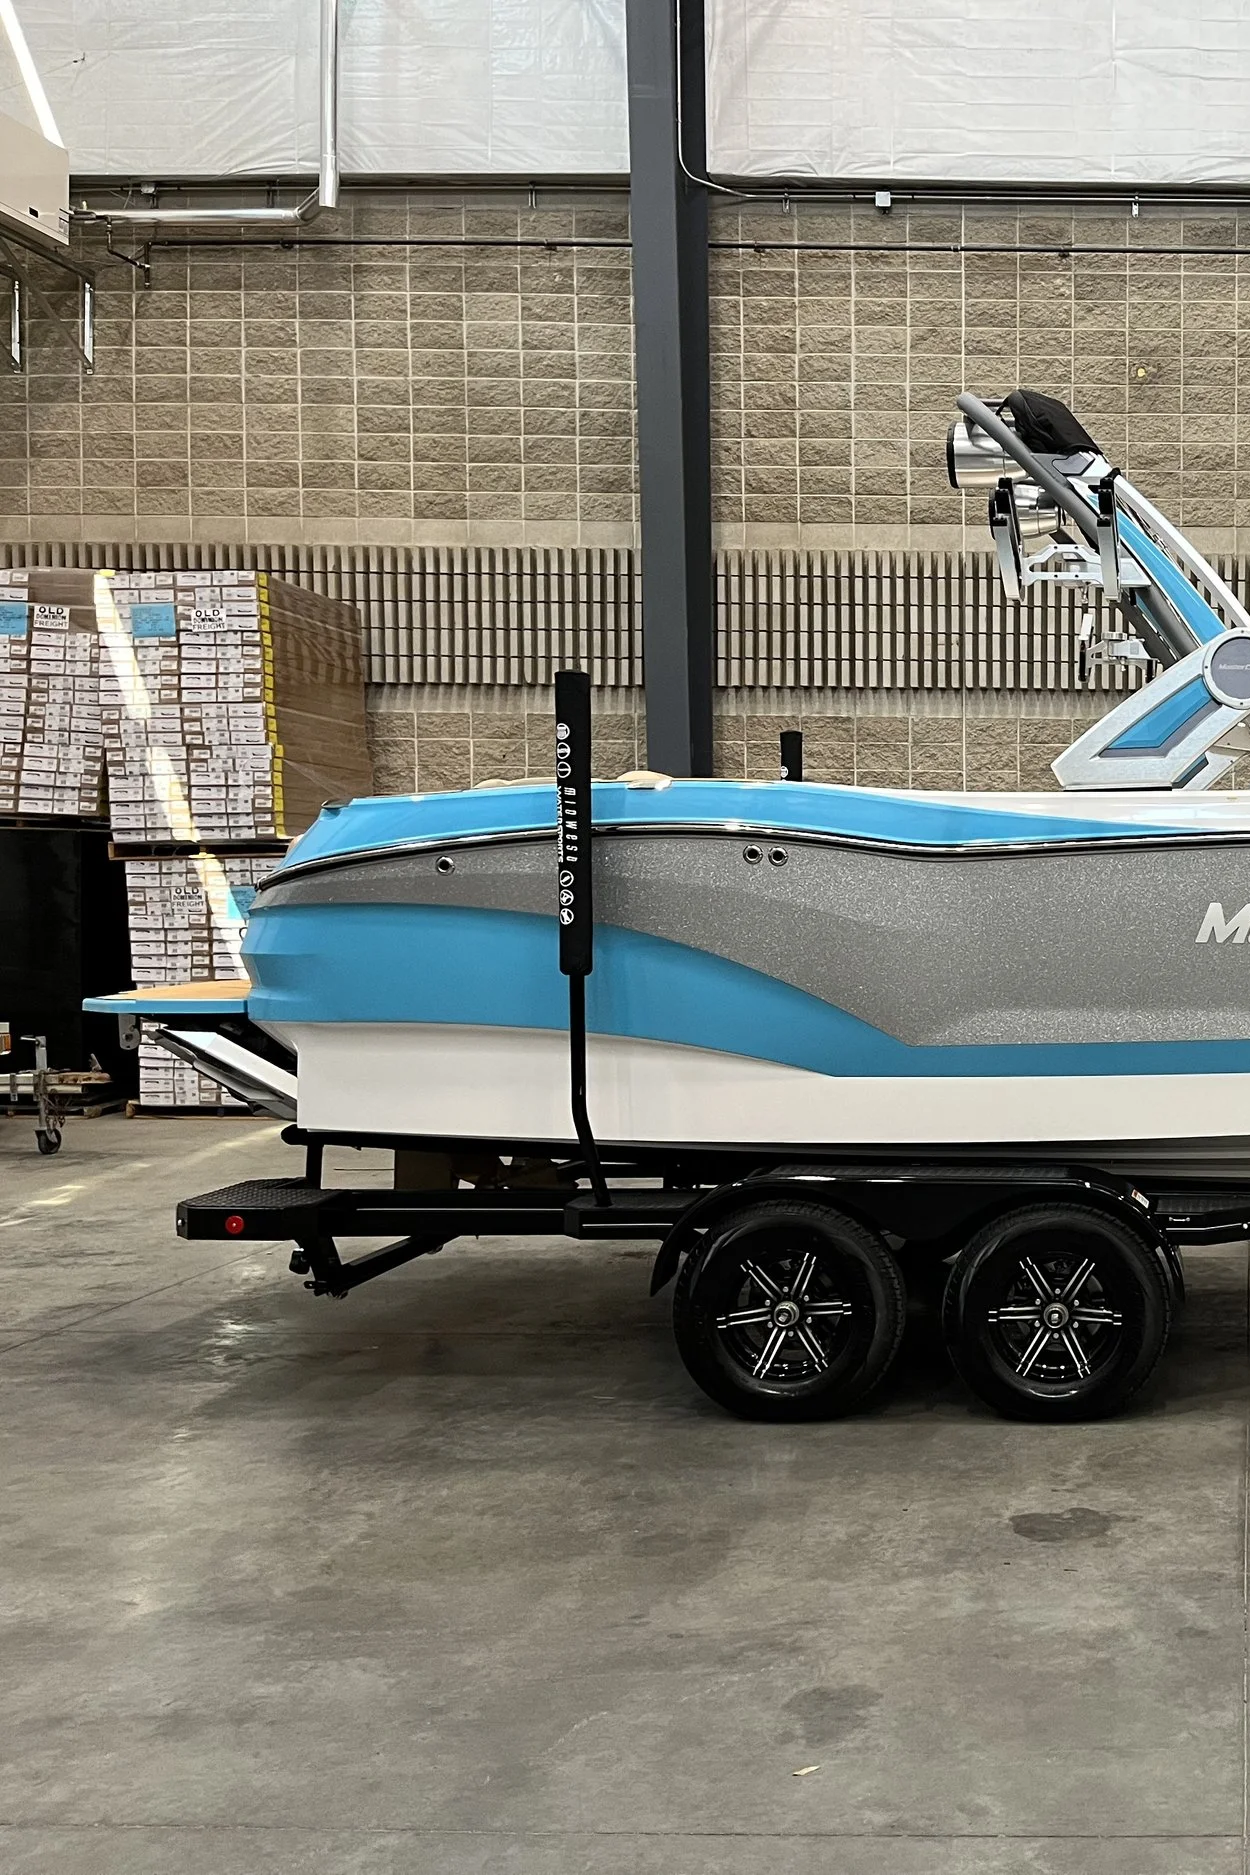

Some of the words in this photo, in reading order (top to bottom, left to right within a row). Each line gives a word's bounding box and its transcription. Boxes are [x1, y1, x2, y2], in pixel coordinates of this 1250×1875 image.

[38, 606, 64, 615] OLD
[195, 609, 220, 618] OLD
[34, 620, 69, 628] FREIGHT
[175, 887, 200, 895] OLD
